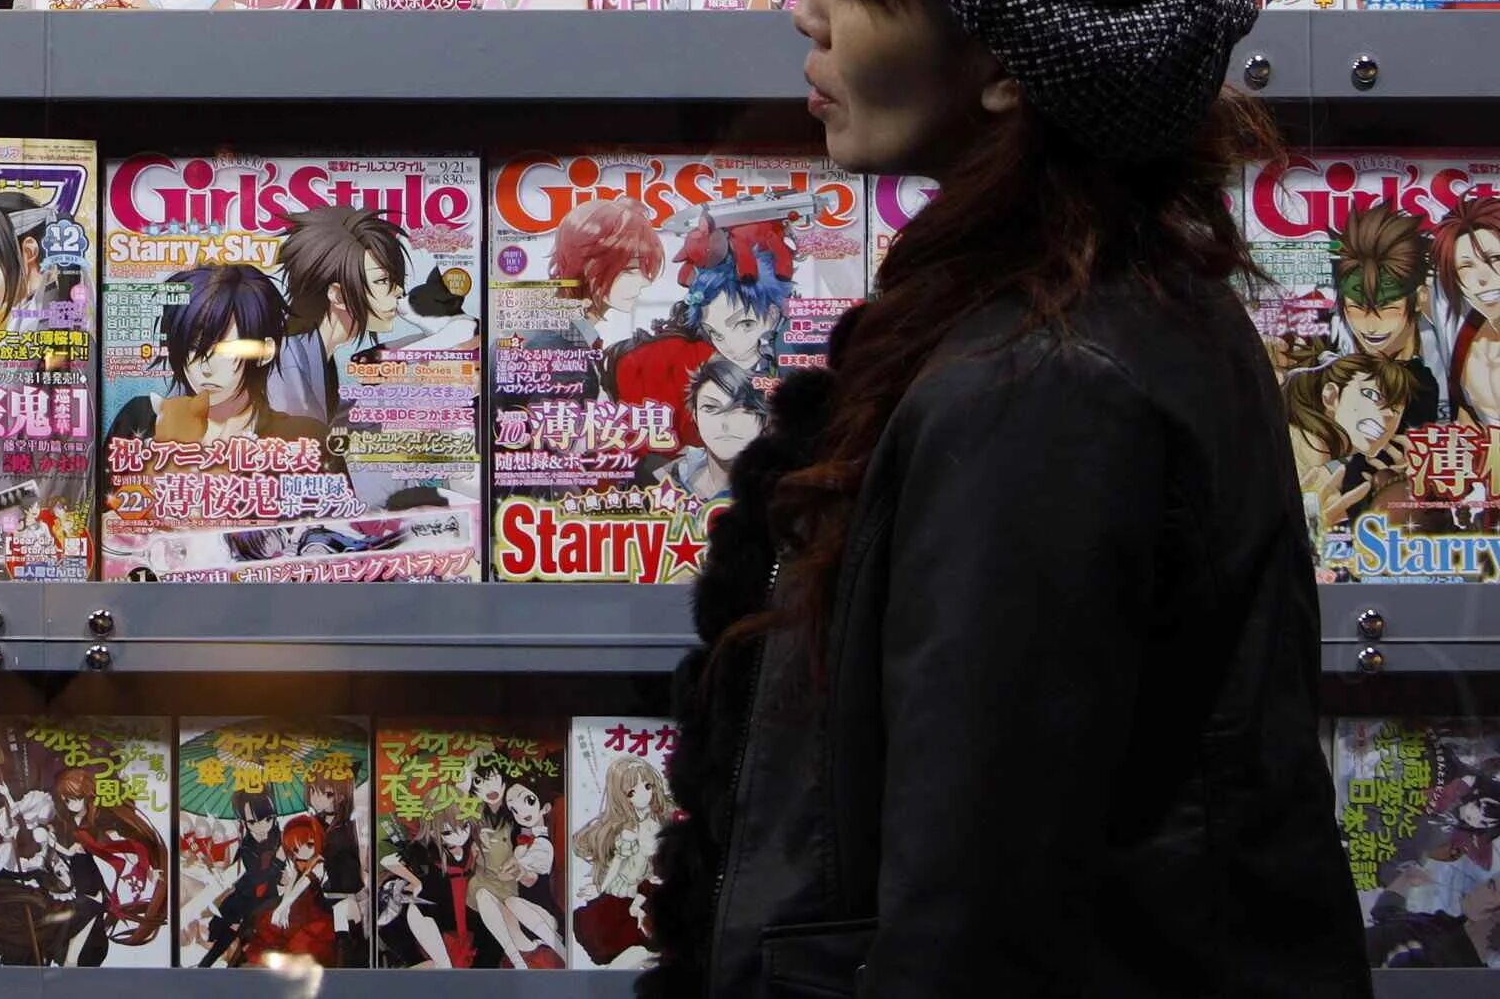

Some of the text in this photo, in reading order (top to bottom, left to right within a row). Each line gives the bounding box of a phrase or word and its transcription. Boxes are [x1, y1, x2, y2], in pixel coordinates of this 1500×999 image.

[328, 161, 425, 172] 電撃ガールズスタイル
[48, 225, 80, 251] 12
[531, 402, 678, 451] 薄桜鬼
[110, 438, 321, 472] 祝・アニメ化発表
[156, 474, 281, 518] 薄桜鬼
